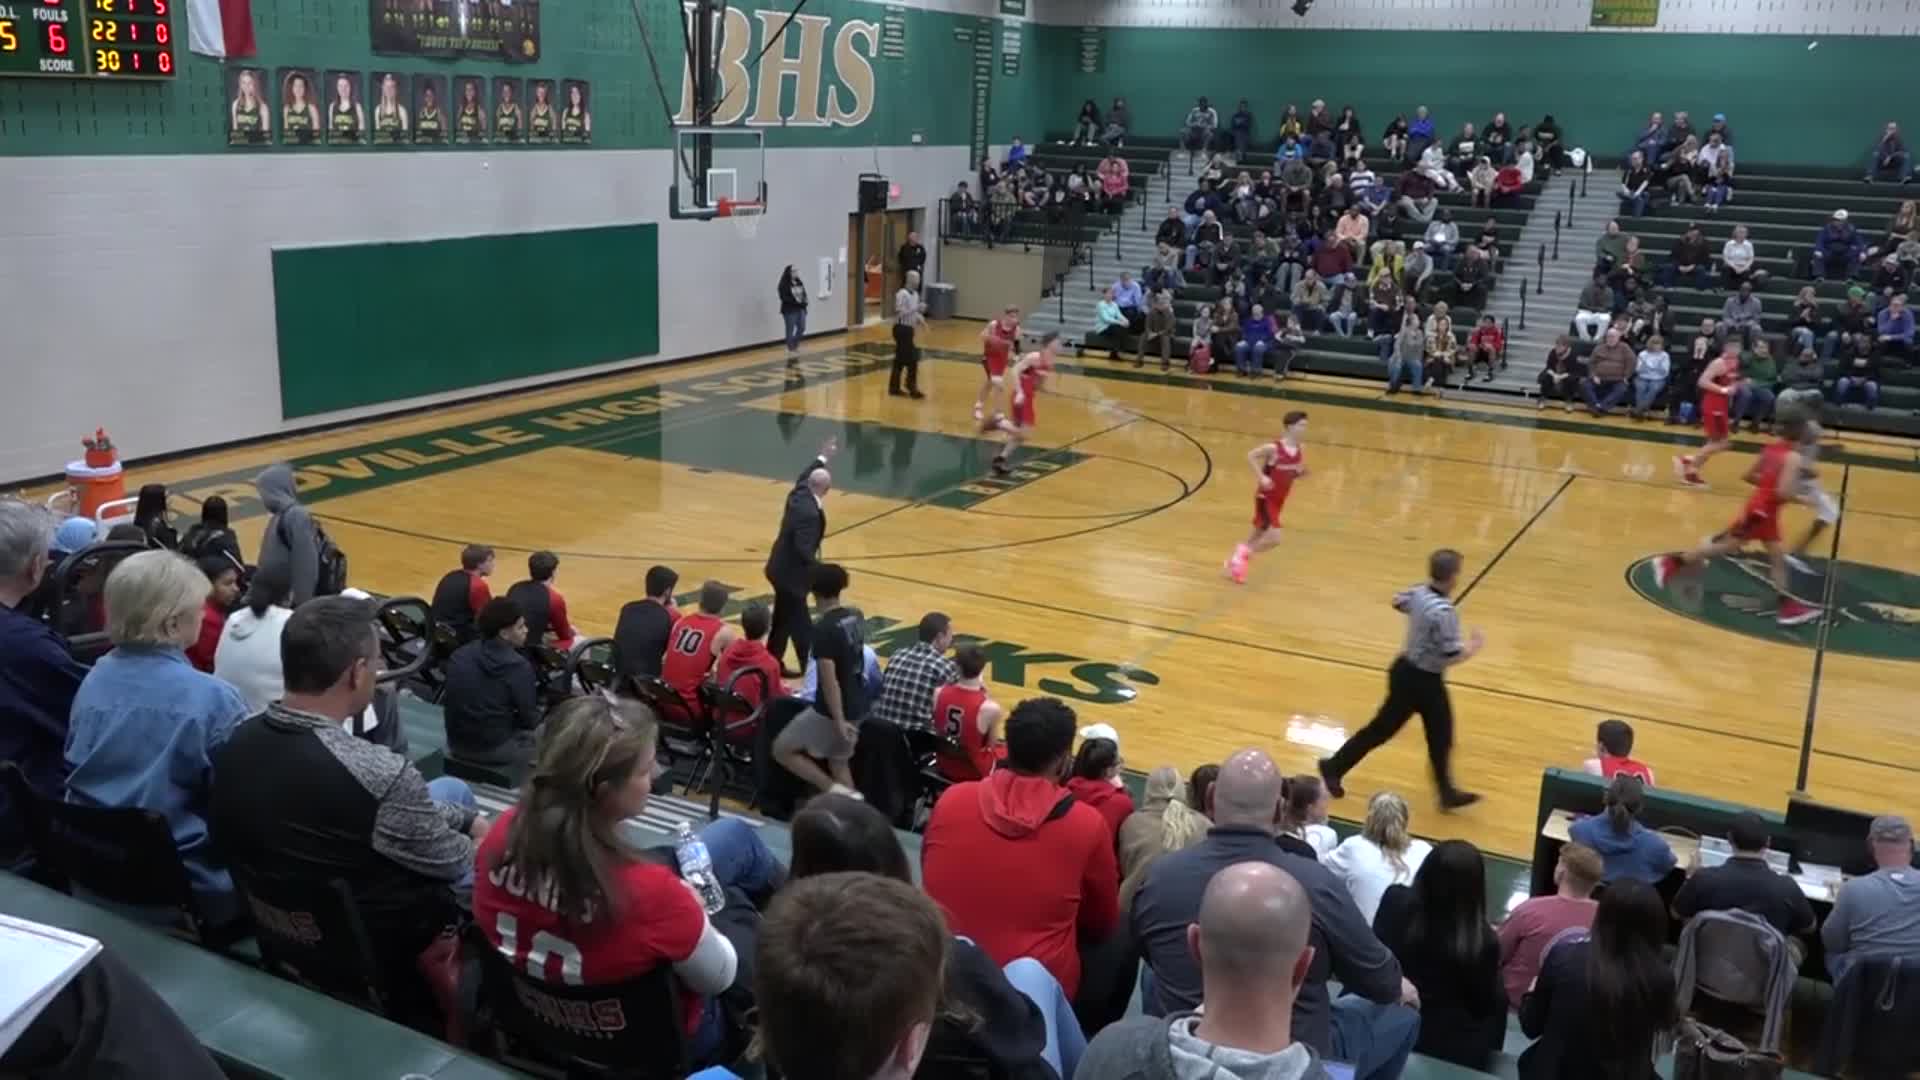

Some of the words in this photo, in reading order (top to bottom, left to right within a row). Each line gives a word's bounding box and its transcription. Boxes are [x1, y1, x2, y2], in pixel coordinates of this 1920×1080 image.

[32, 7, 69, 22] FOULS
[0, 21, 17, 50] 5
[48, 24, 65, 52] 6
[92, 19, 117, 41] 22
[156, 23, 168, 43] 0
[39, 58, 75, 72] SCORE
[96, 49, 120, 71] 30
[158, 52, 171, 72] 0
[672, 2, 880, 127] BHS
[528, 390, 705, 432] HIGH
[672, 625, 704, 656] 10
[945, 704, 965, 738] 5
